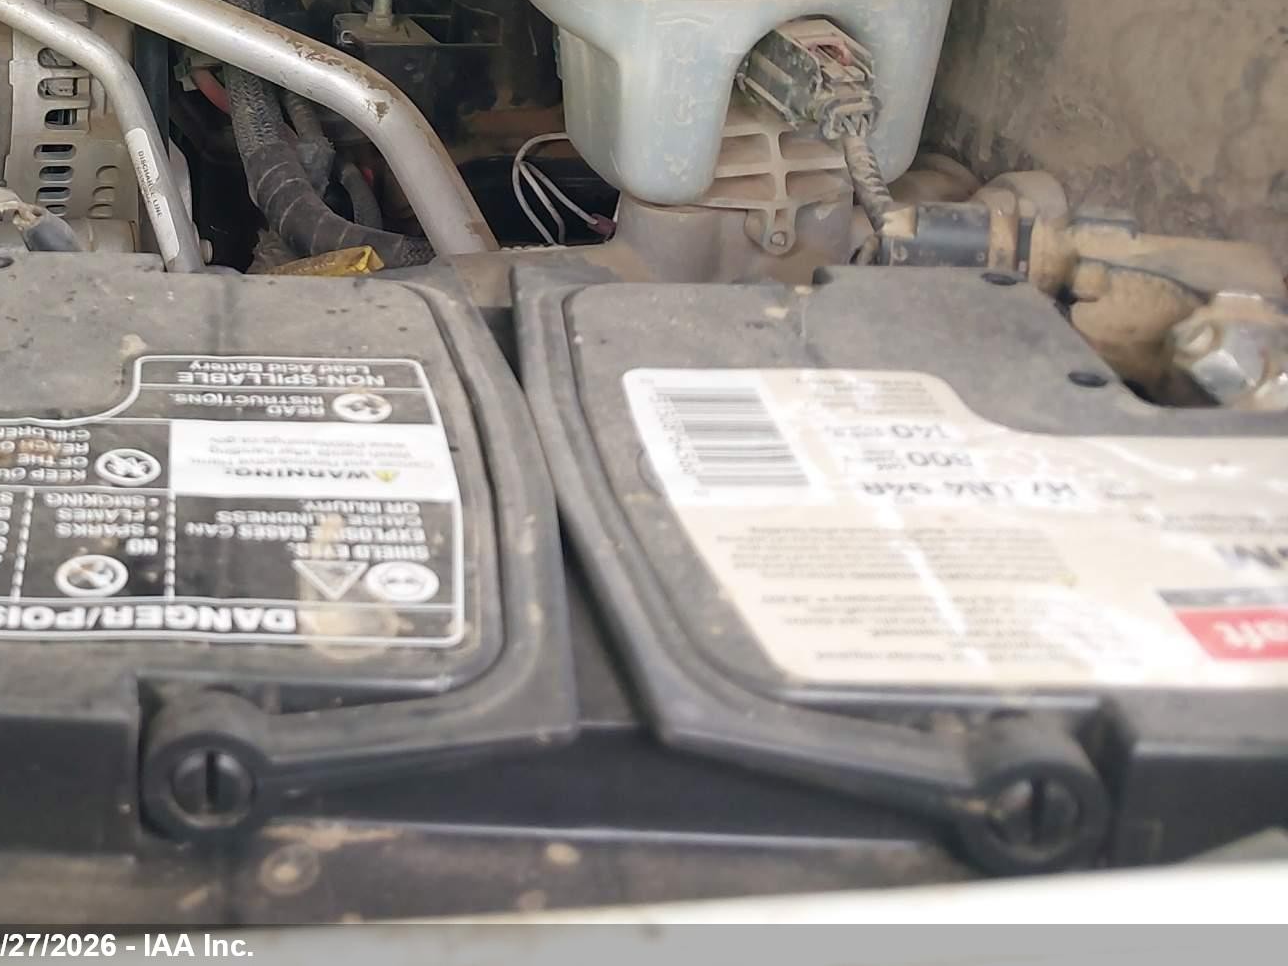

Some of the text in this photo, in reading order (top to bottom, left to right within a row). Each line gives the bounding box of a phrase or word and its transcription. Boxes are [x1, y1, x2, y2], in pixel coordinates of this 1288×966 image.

[137, 150, 155, 197] DISCHARE
[188, 358, 368, 377] Lead Acid Battery
[176, 369, 385, 386] NON-SPILLABLE
[267, 402, 325, 415] READ
[19, 436, 90, 454] REACH
[16, 453, 89, 468] OF THE
[29, 466, 87, 482] KEEP
[223, 466, 369, 480] WARNING:
[44, 491, 145, 508] SMOKING
[383, 500, 419, 515] OR
[56, 506, 145, 522] FLAMES
[216, 509, 422, 528] CAUSE LINDNESS
[55, 521, 144, 537] SPARKS
[186, 521, 234, 537] CAN
[238, 524, 306, 540] GASES
[125, 537, 158, 554] NO
[353, 543, 429, 561] SHIELD
